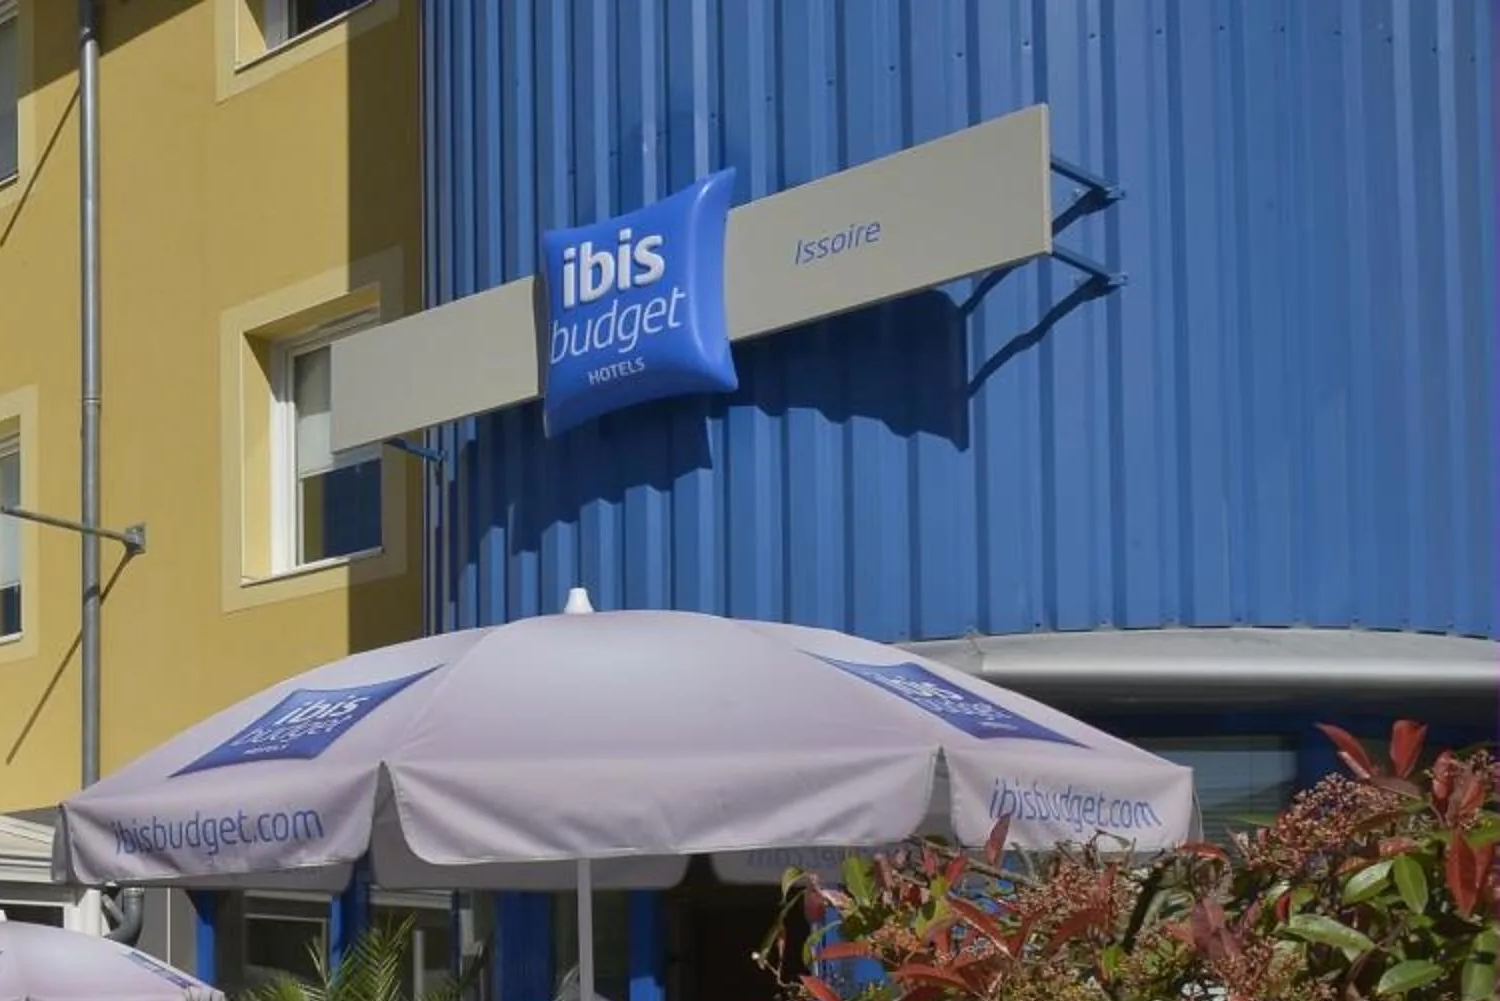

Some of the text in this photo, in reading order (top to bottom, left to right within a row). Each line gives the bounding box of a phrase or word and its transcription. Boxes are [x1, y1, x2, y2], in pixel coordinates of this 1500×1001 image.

[562, 227, 666, 310] ibis
[794, 221, 882, 267] Issoire
[549, 287, 686, 364] budget
[588, 356, 645, 385] HOTELS
[272, 695, 371, 726] ibis
[108, 804, 326, 857] ibisbudget.com
[989, 777, 1161, 833] ibisbudget.com
